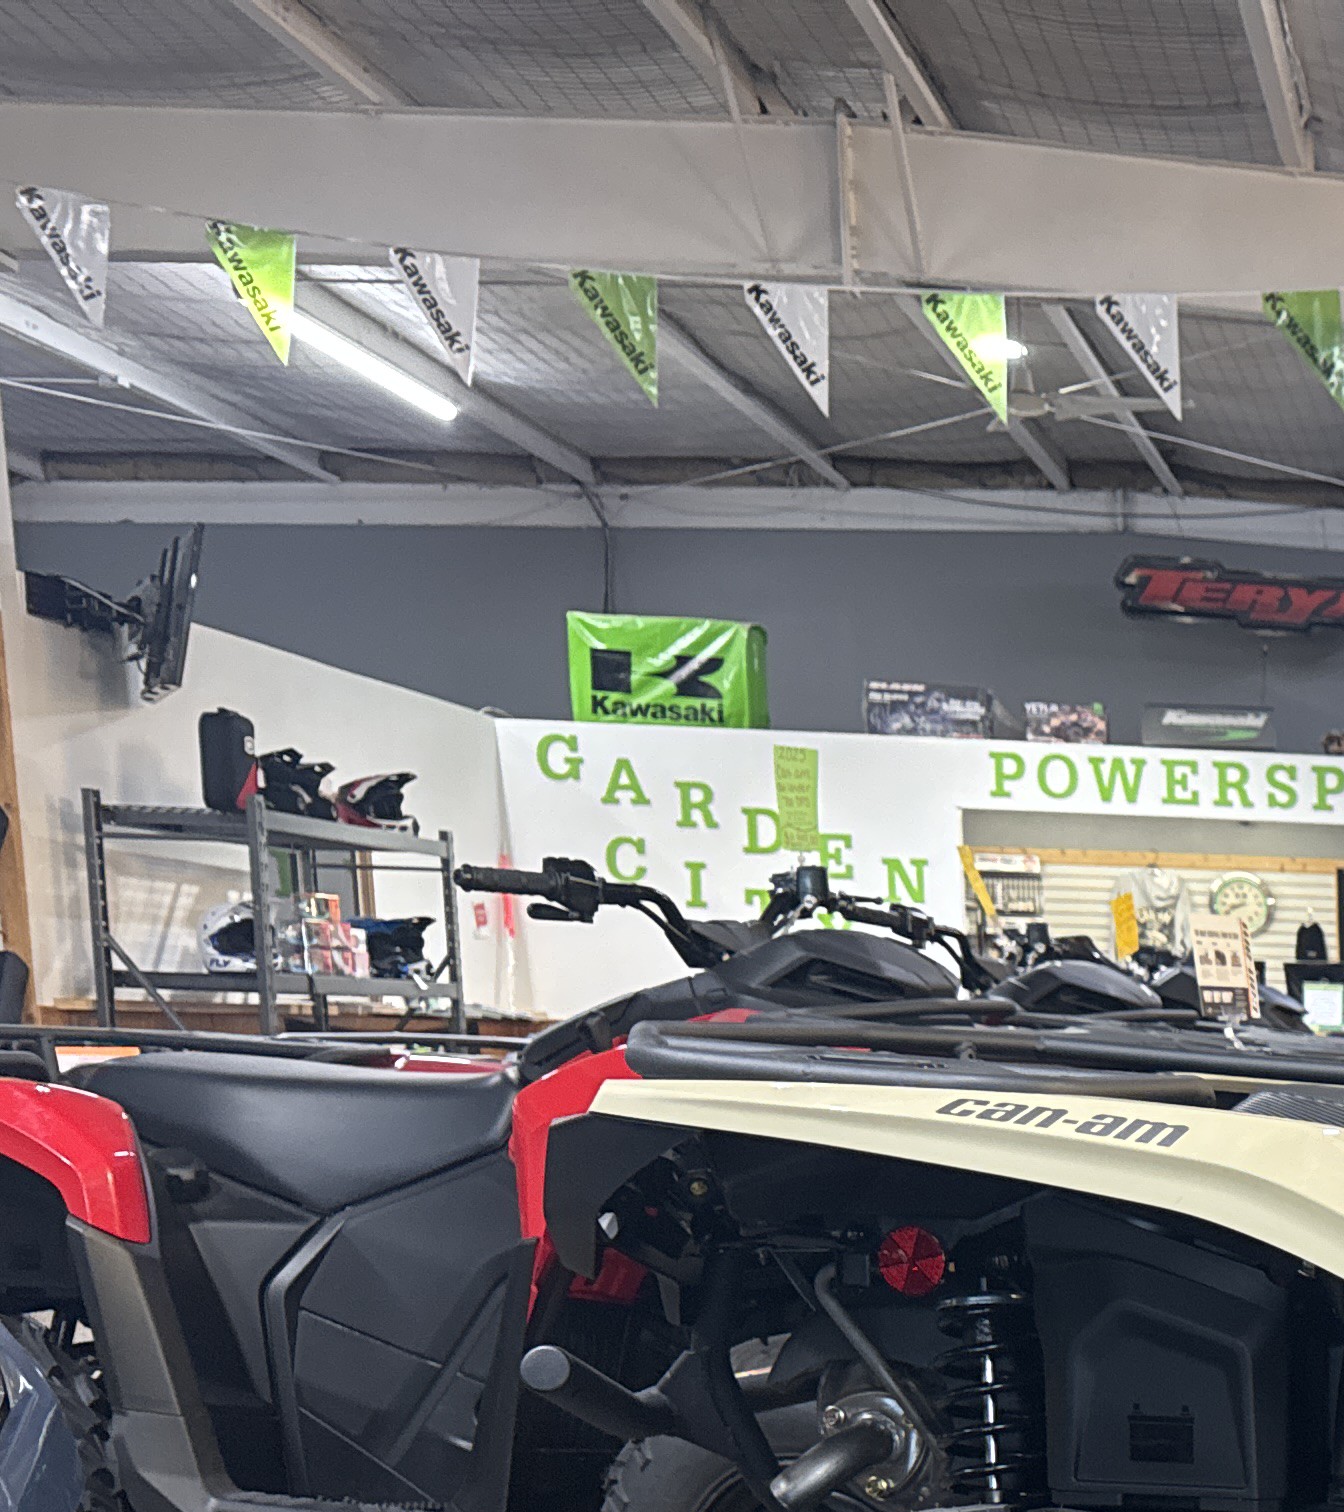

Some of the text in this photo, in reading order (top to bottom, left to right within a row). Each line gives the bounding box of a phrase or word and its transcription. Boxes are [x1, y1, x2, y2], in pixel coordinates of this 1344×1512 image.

[207, 219, 283, 333] Kawasaki
[394, 247, 472, 357] Kawasaki
[571, 271, 651, 377] Kawasaki
[747, 282, 827, 388] Kawasaki
[924, 293, 1003, 397] Kawasaki
[1100, 293, 1176, 396] Kawasaki
[590, 694, 725, 725] Kawasaki
[934, 1098, 1191, 1149] can-am
